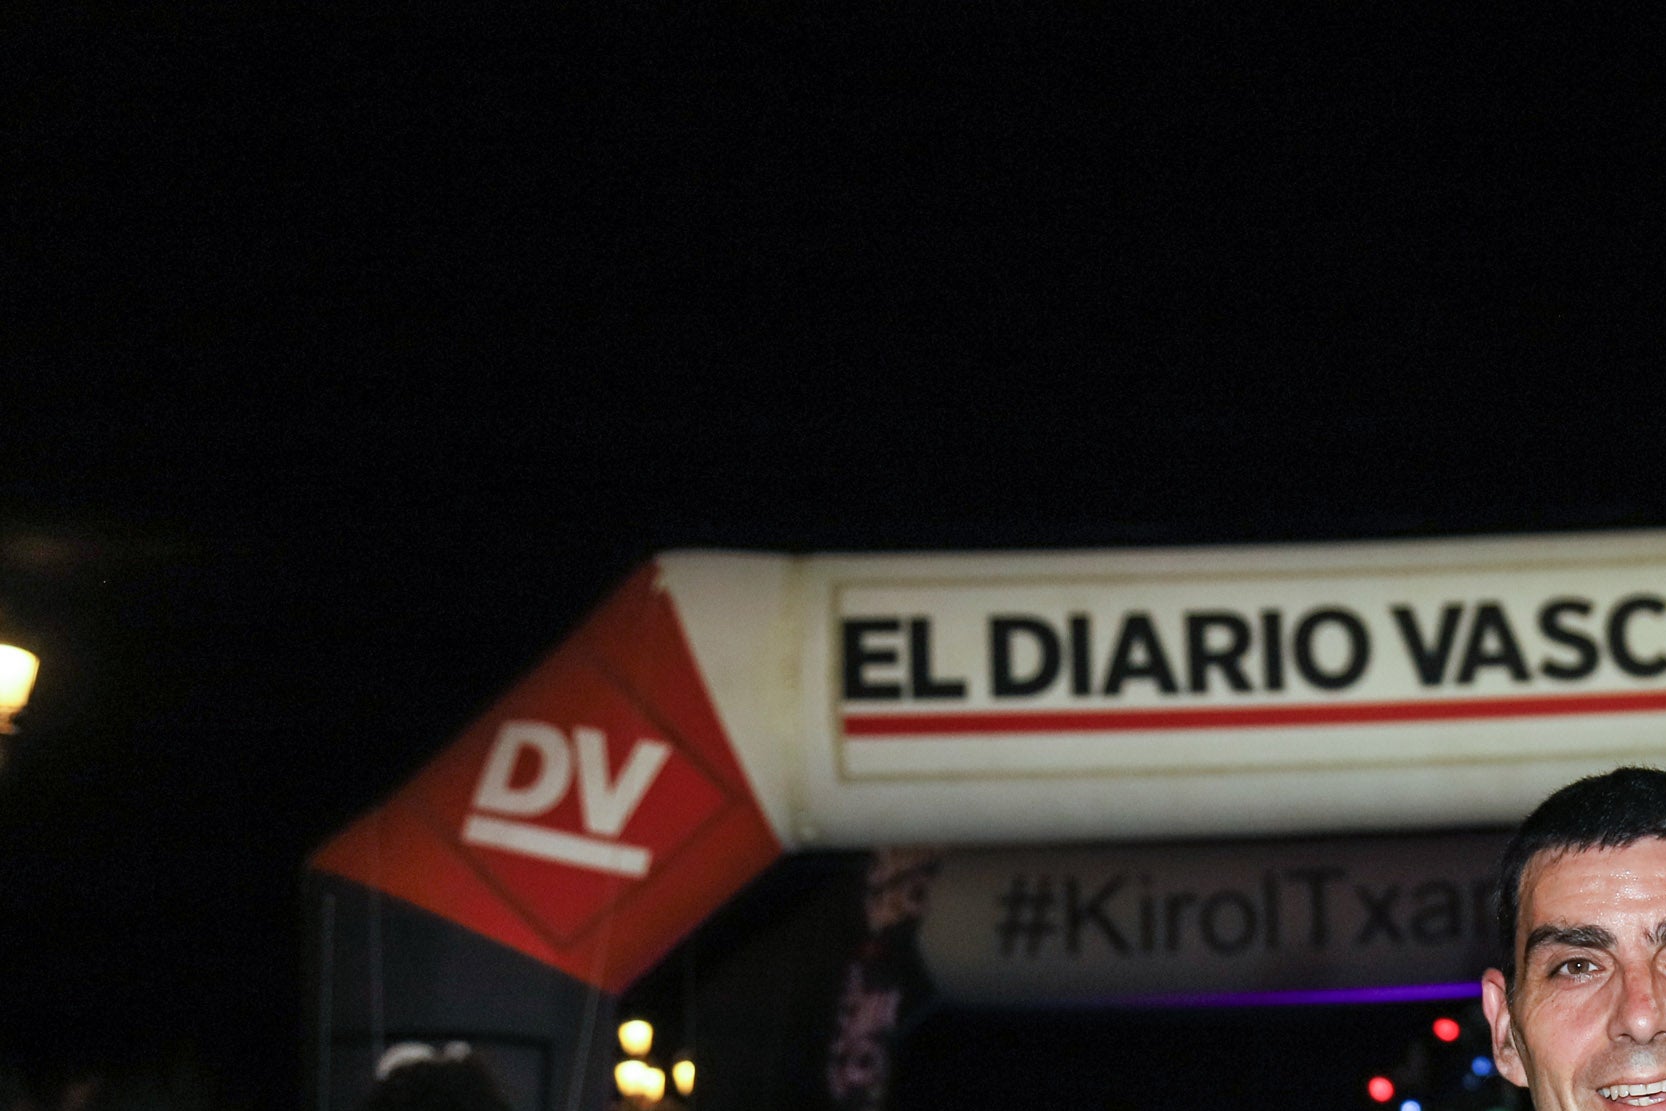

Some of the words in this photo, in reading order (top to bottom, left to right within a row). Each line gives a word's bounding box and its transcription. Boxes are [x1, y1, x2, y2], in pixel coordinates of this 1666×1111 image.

[841, 615, 966, 702] EL
[990, 605, 1372, 700] DIARIO
[472, 720, 674, 838] DV
